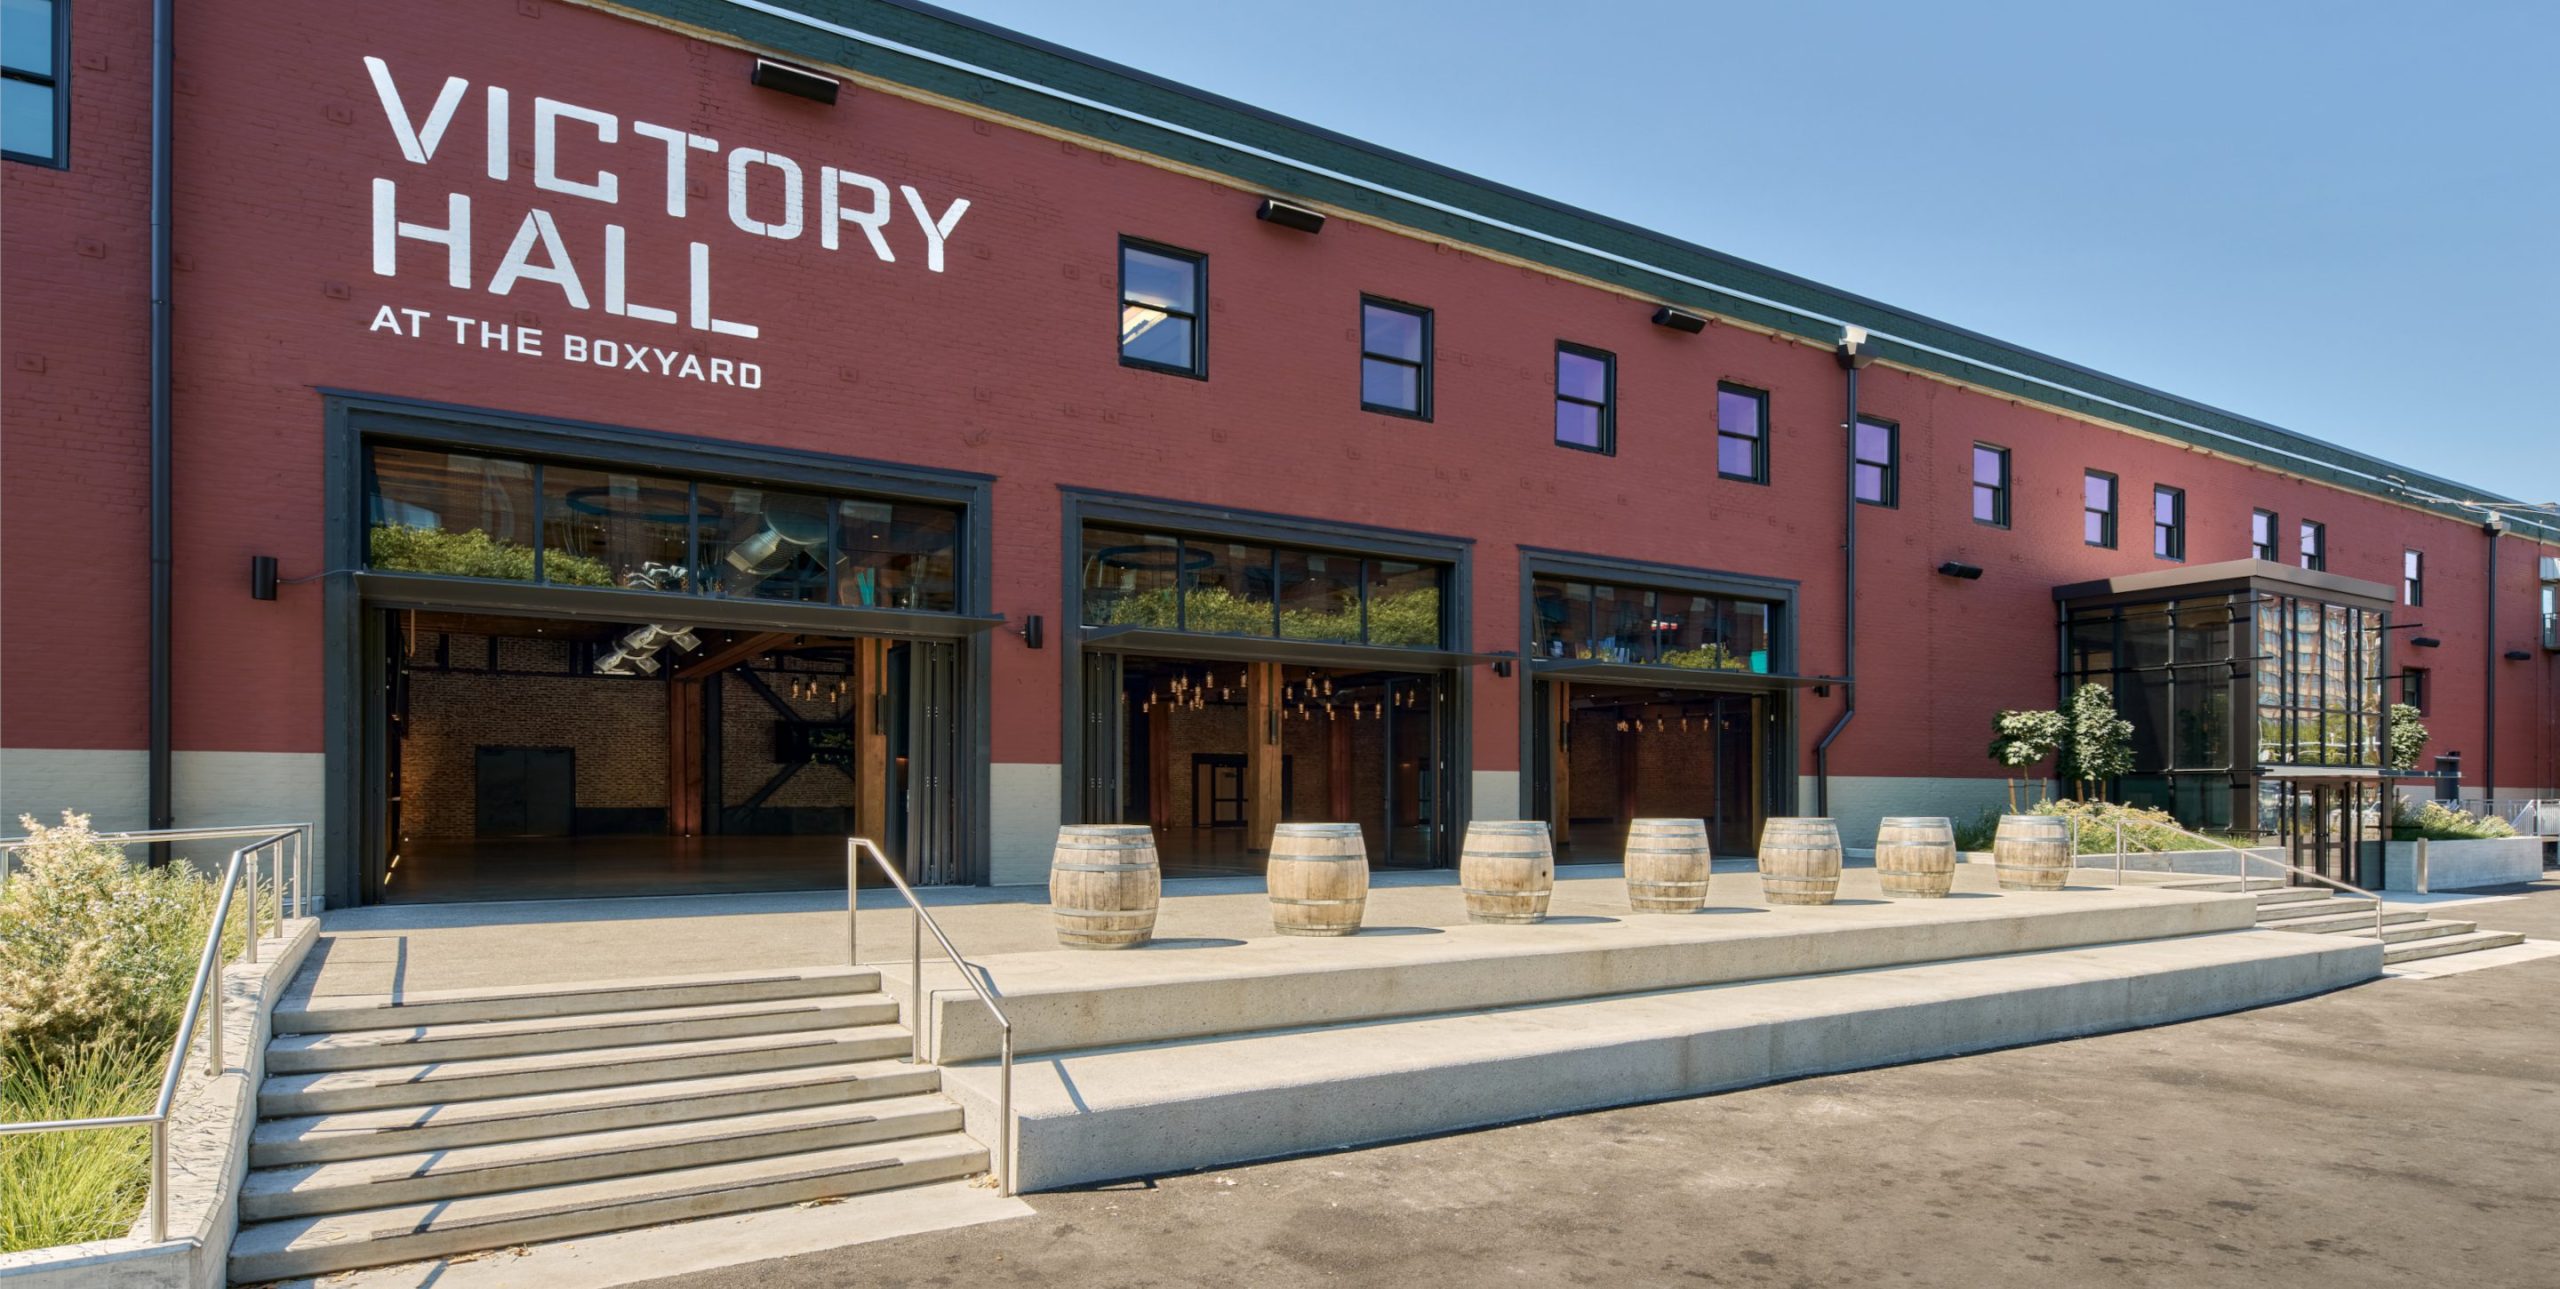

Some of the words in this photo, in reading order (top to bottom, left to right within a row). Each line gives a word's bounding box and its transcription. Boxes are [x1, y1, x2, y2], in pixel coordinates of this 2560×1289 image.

[363, 55, 971, 273] VICTORY
[372, 177, 760, 340] HALL
[369, 304, 431, 338] AT
[447, 314, 543, 357] THE
[564, 334, 763, 390] BOXYARD
